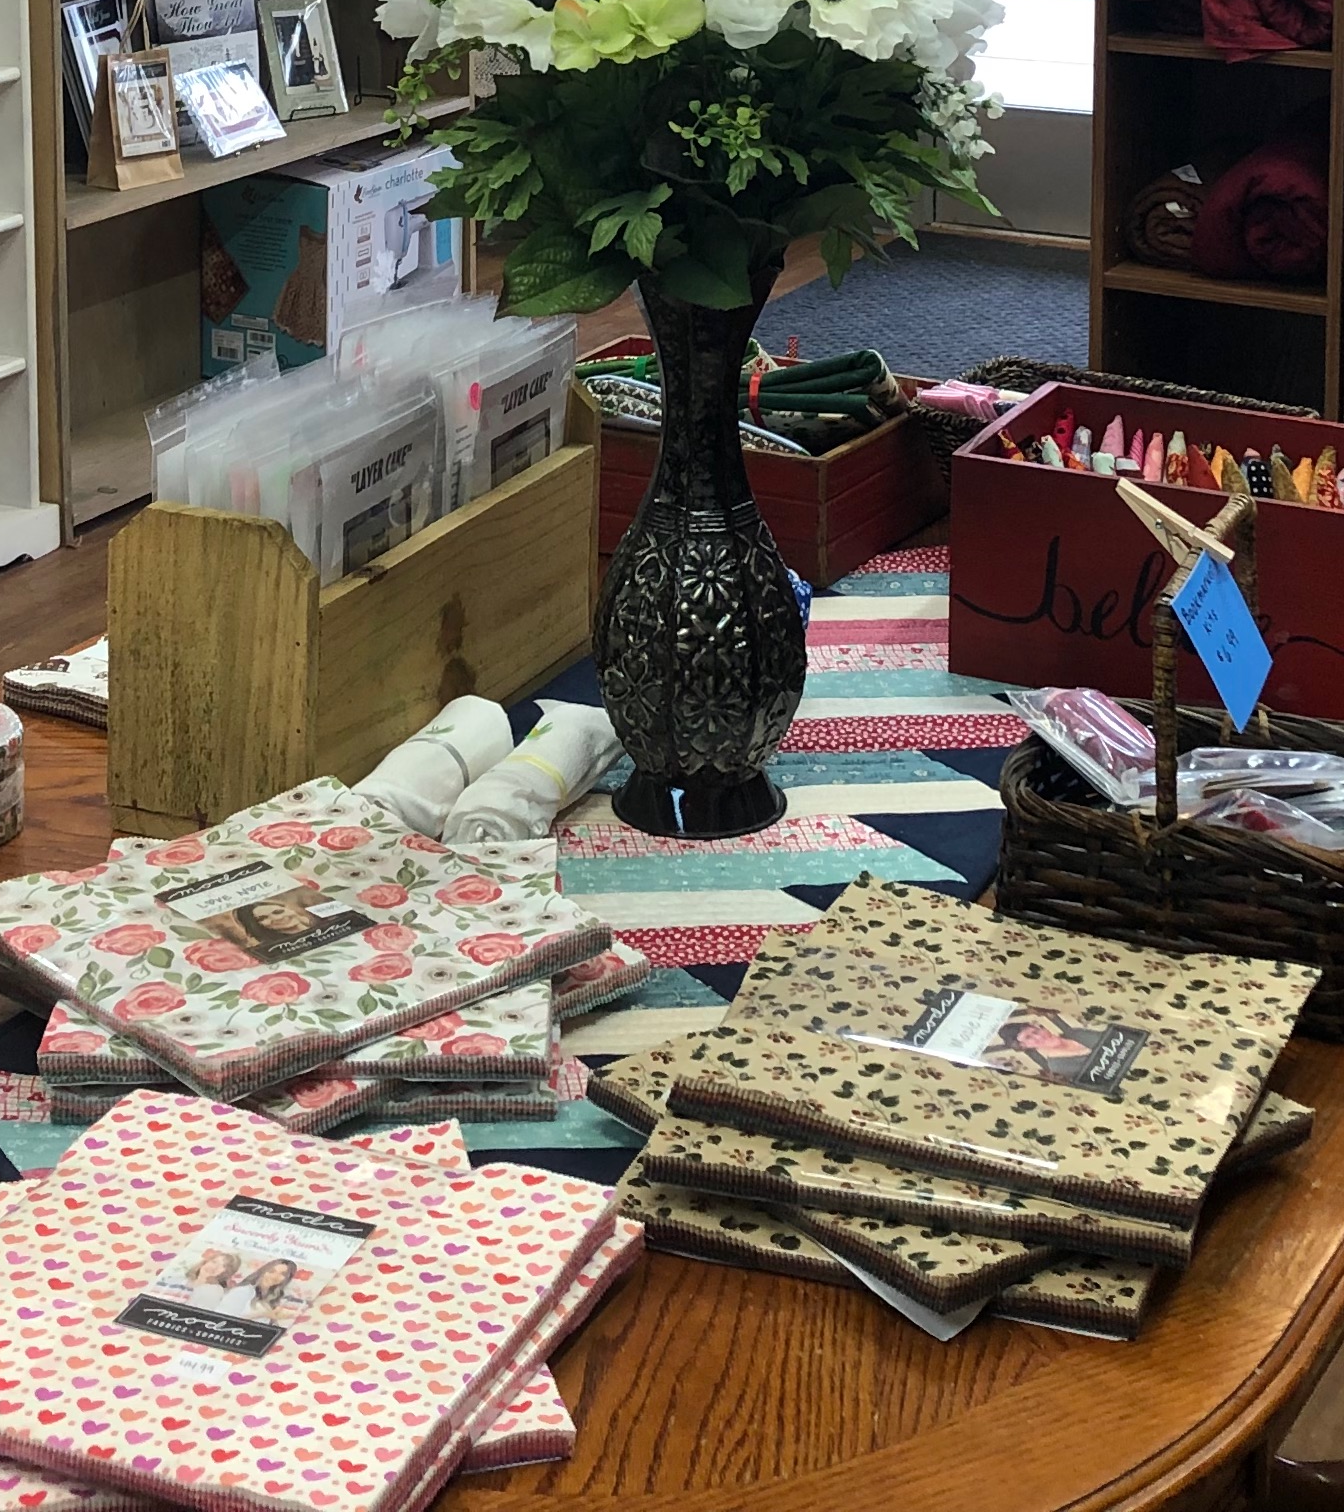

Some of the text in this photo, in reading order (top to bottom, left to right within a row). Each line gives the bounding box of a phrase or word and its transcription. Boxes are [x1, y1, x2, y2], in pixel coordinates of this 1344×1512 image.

[164, 0, 201, 19] How
[174, 16, 213, 34] Thou
[385, 167, 424, 189] charlotte
[168, 865, 263, 900] moda
[196, 893, 230, 909] LOVE
[237, 879, 273, 896] NOTE
[268, 920, 351, 952] moda
[913, 991, 955, 1046] moda
[1090, 1031, 1124, 1082] moda
[237, 1202, 363, 1233] moda
[143, 1308, 263, 1339] moda
[146, 1317, 243, 1347] FABRICS SUPPLIES
